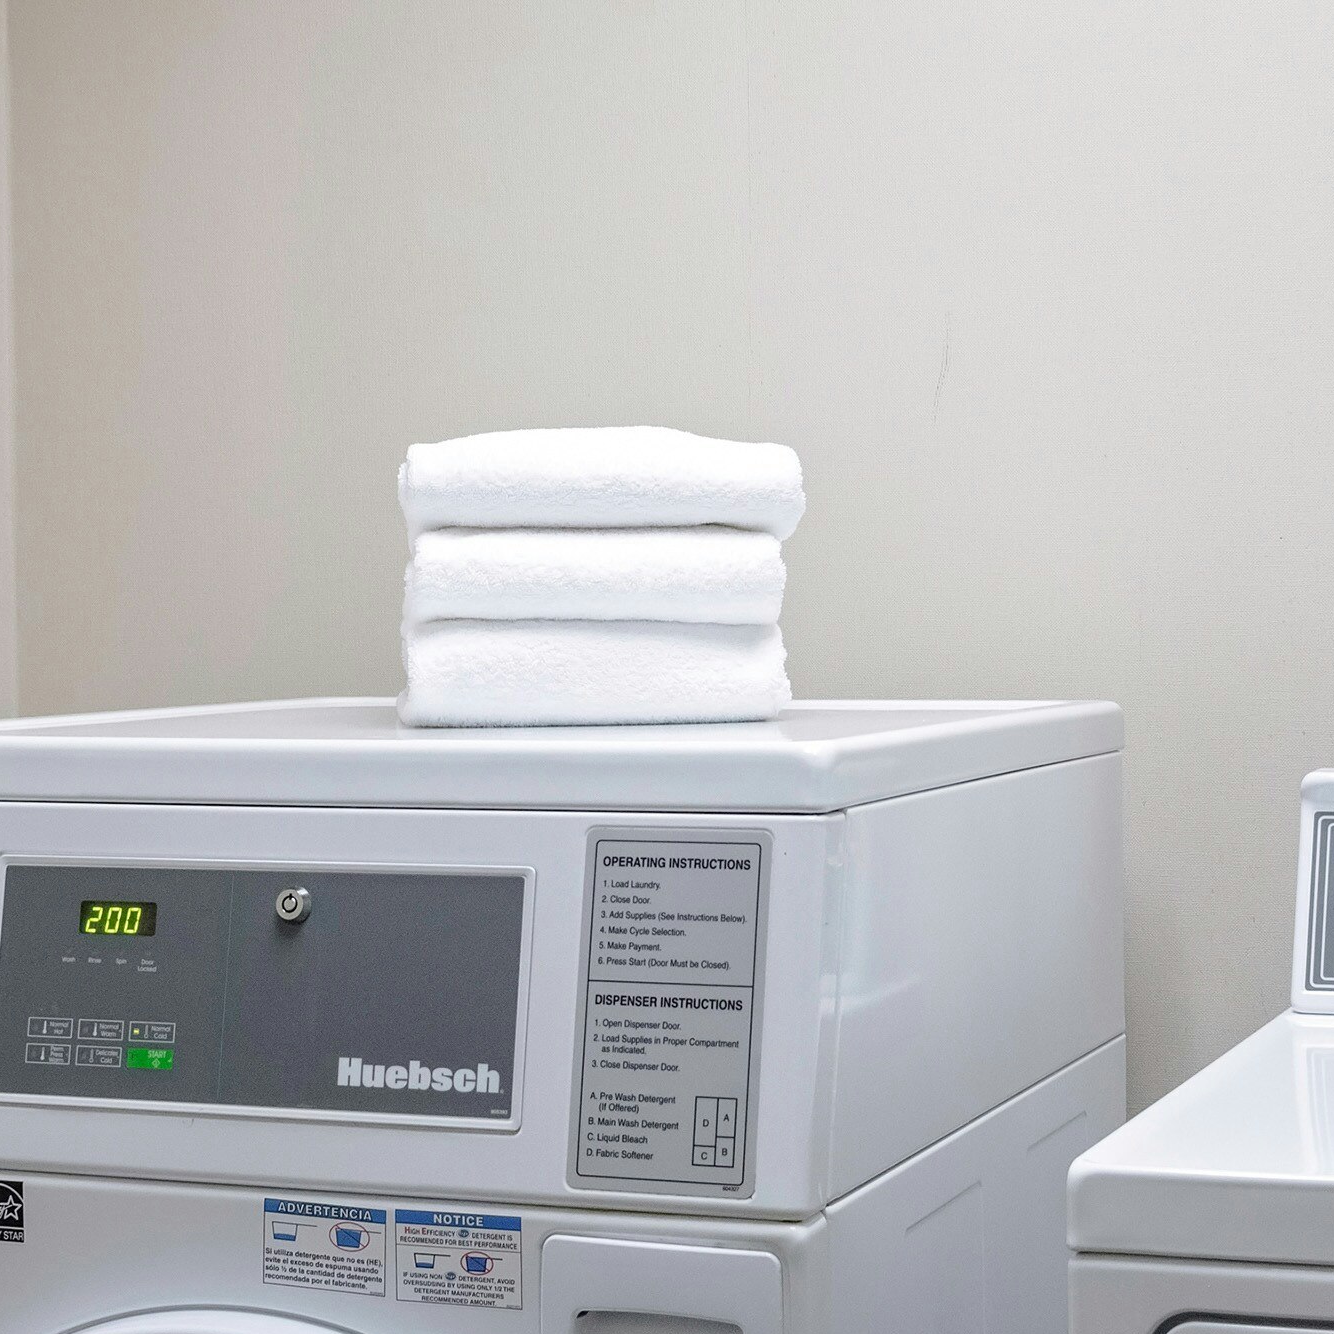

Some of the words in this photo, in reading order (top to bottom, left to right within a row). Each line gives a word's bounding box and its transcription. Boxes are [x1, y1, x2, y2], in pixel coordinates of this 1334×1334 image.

[603, 856, 666, 868] OPERATING
[669, 858, 751, 870] INSTRUCTIONS
[611, 880, 629, 888] Load
[631, 881, 661, 890] Laundry.
[633, 896, 651, 904] Door.
[85, 907, 141, 933] 200
[609, 911, 624, 919] Add
[626, 912, 656, 920] Supplies
[658, 912, 675, 921] (See
[677, 913, 718, 921] Instructions
[721, 914, 747, 924] Below).
[630, 927, 649, 937] Cycle
[652, 928, 686, 936] Selection.
[607, 942, 626, 950] Make
[629, 943, 661, 952] Payment.
[607, 957, 627, 965] Press
[629, 958, 646, 966] Start
[648, 959, 668, 968] (Door
[670, 960, 688, 968] Must
[690, 960, 699, 968] be
[701, 961, 731, 970] Closed).
[595, 995, 657, 1007] DISPENSER
[661, 997, 743, 1011] INSTRUCTIONS
[603, 1019, 622, 1029] Open
[624, 1020, 660, 1030] Dispenser
[622, 1035, 652, 1044] Supplies
[663, 1037, 687, 1046] Proper
[689, 1038, 739, 1048] Compartment
[148, 1050, 166, 1058] START
[600, 1061, 620, 1069] Close
[623, 1062, 658, 1071] Dispenser
[337, 1057, 501, 1094] Huebsch
[600, 1092, 613, 1100] Pre
[615, 1093, 636, 1101] Wash
[639, 1095, 676, 1105] Detergent
[599, 1103, 607, 1112] (If
[609, 1104, 639, 1113] Offered)
[598, 1118, 616, 1126] Main
[618, 1119, 639, 1127] Wash
[641, 1120, 679, 1130] Detergent
[703, 1119, 709, 1127] D
[597, 1134, 619, 1143] Liquid
[622, 1135, 648, 1144] Bleach
[596, 1150, 618, 1158] Fabric
[621, 1151, 653, 1160] Softener
[278, 1202, 371, 1220] ADVERTENCIA
[434, 1214, 484, 1226] NOTICE
[3, 1231, 24, 1240] STAR
